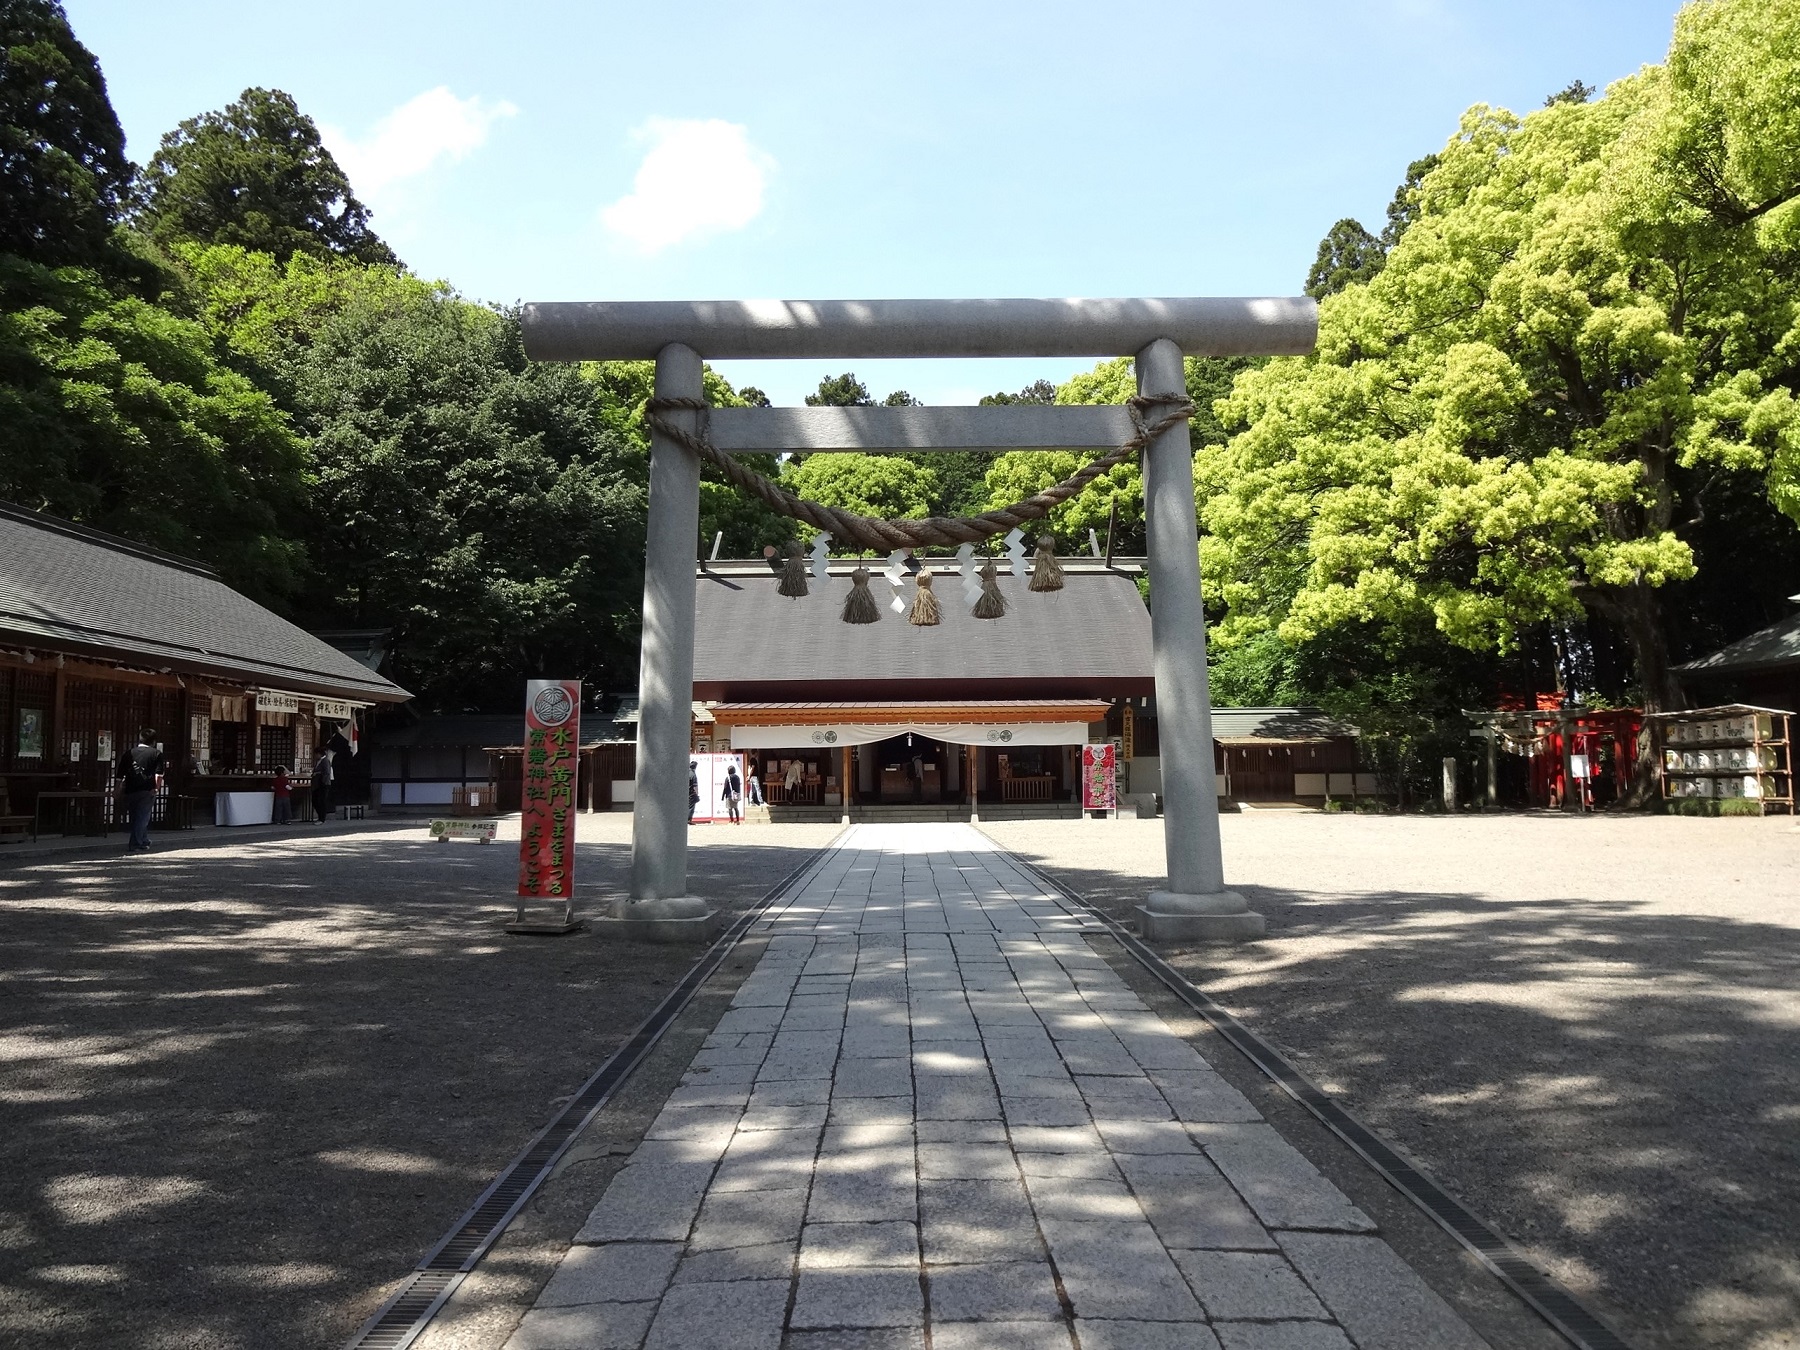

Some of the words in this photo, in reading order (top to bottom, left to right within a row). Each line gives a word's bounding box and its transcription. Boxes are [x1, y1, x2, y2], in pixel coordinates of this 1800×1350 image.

[526, 729, 547, 894] 常磐神社へようこそ
[547, 727, 574, 894] 水戸黄門さまをまつる
